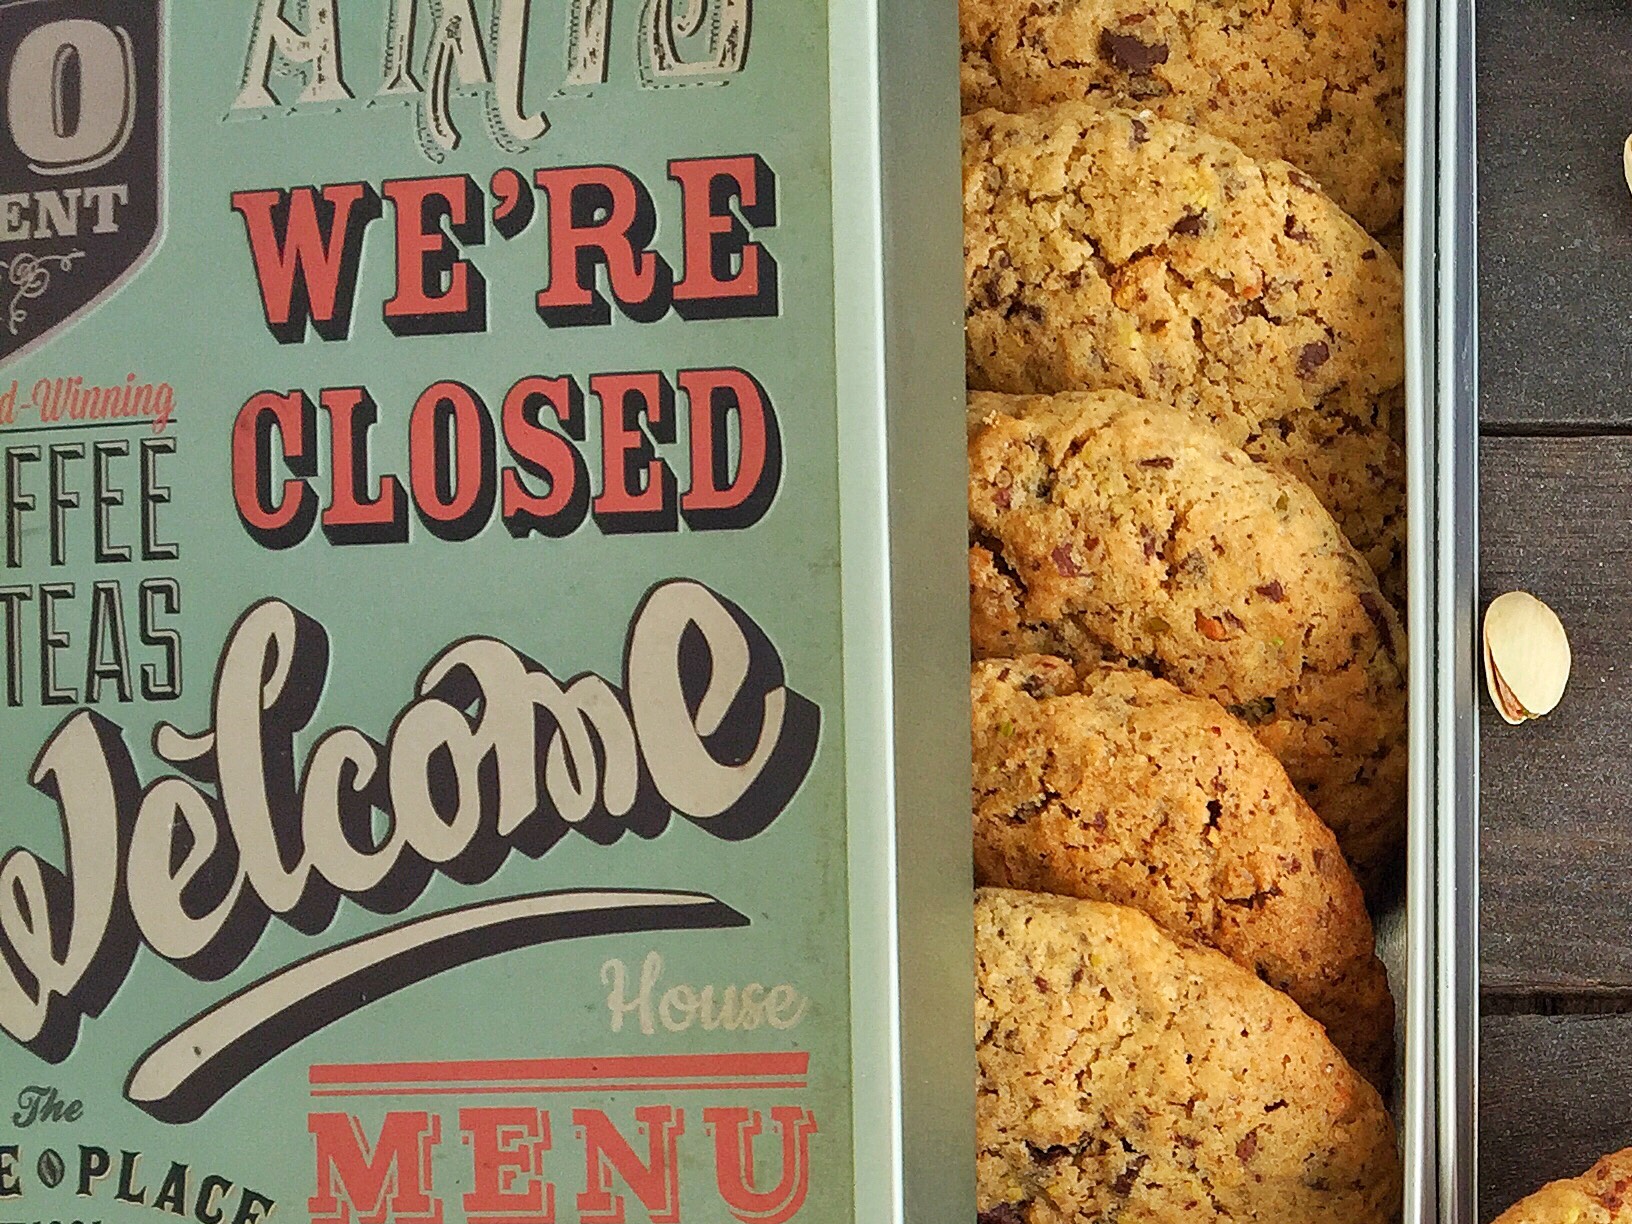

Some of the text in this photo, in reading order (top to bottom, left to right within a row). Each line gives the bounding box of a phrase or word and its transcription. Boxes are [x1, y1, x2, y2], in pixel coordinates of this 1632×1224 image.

[0, 184, 129, 242] ENT
[5, 436, 180, 569] FFEE
[231, 365, 783, 551] CLOSED
[0, 577, 183, 707] TEAS
[600, 950, 808, 1037] House
[12, 1085, 85, 1129] The
